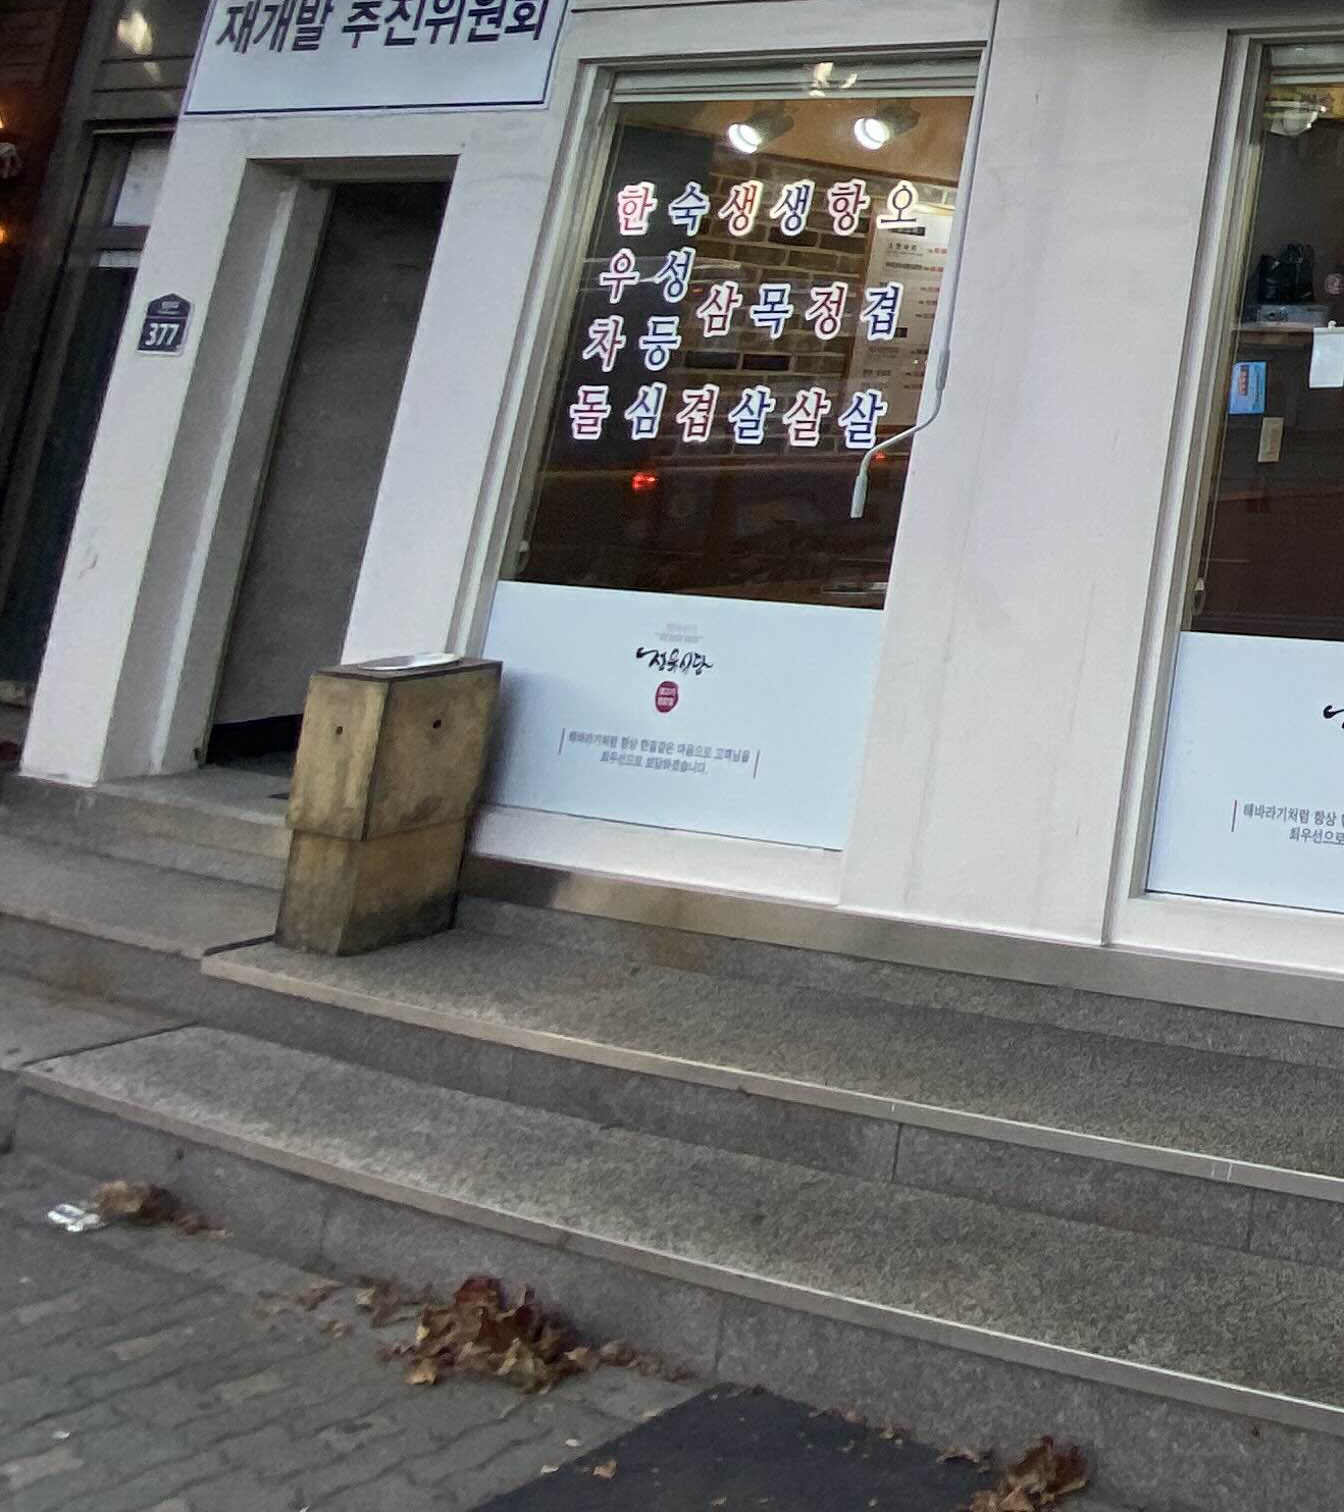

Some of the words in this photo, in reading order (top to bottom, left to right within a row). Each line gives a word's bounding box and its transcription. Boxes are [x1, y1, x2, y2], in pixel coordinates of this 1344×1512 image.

[145, 323, 180, 345] 377
[1243, 803, 1309, 824] 해바라기처럼
[1314, 810, 1336, 827] 항상
[1289, 827, 1344, 847] 최우선으로
